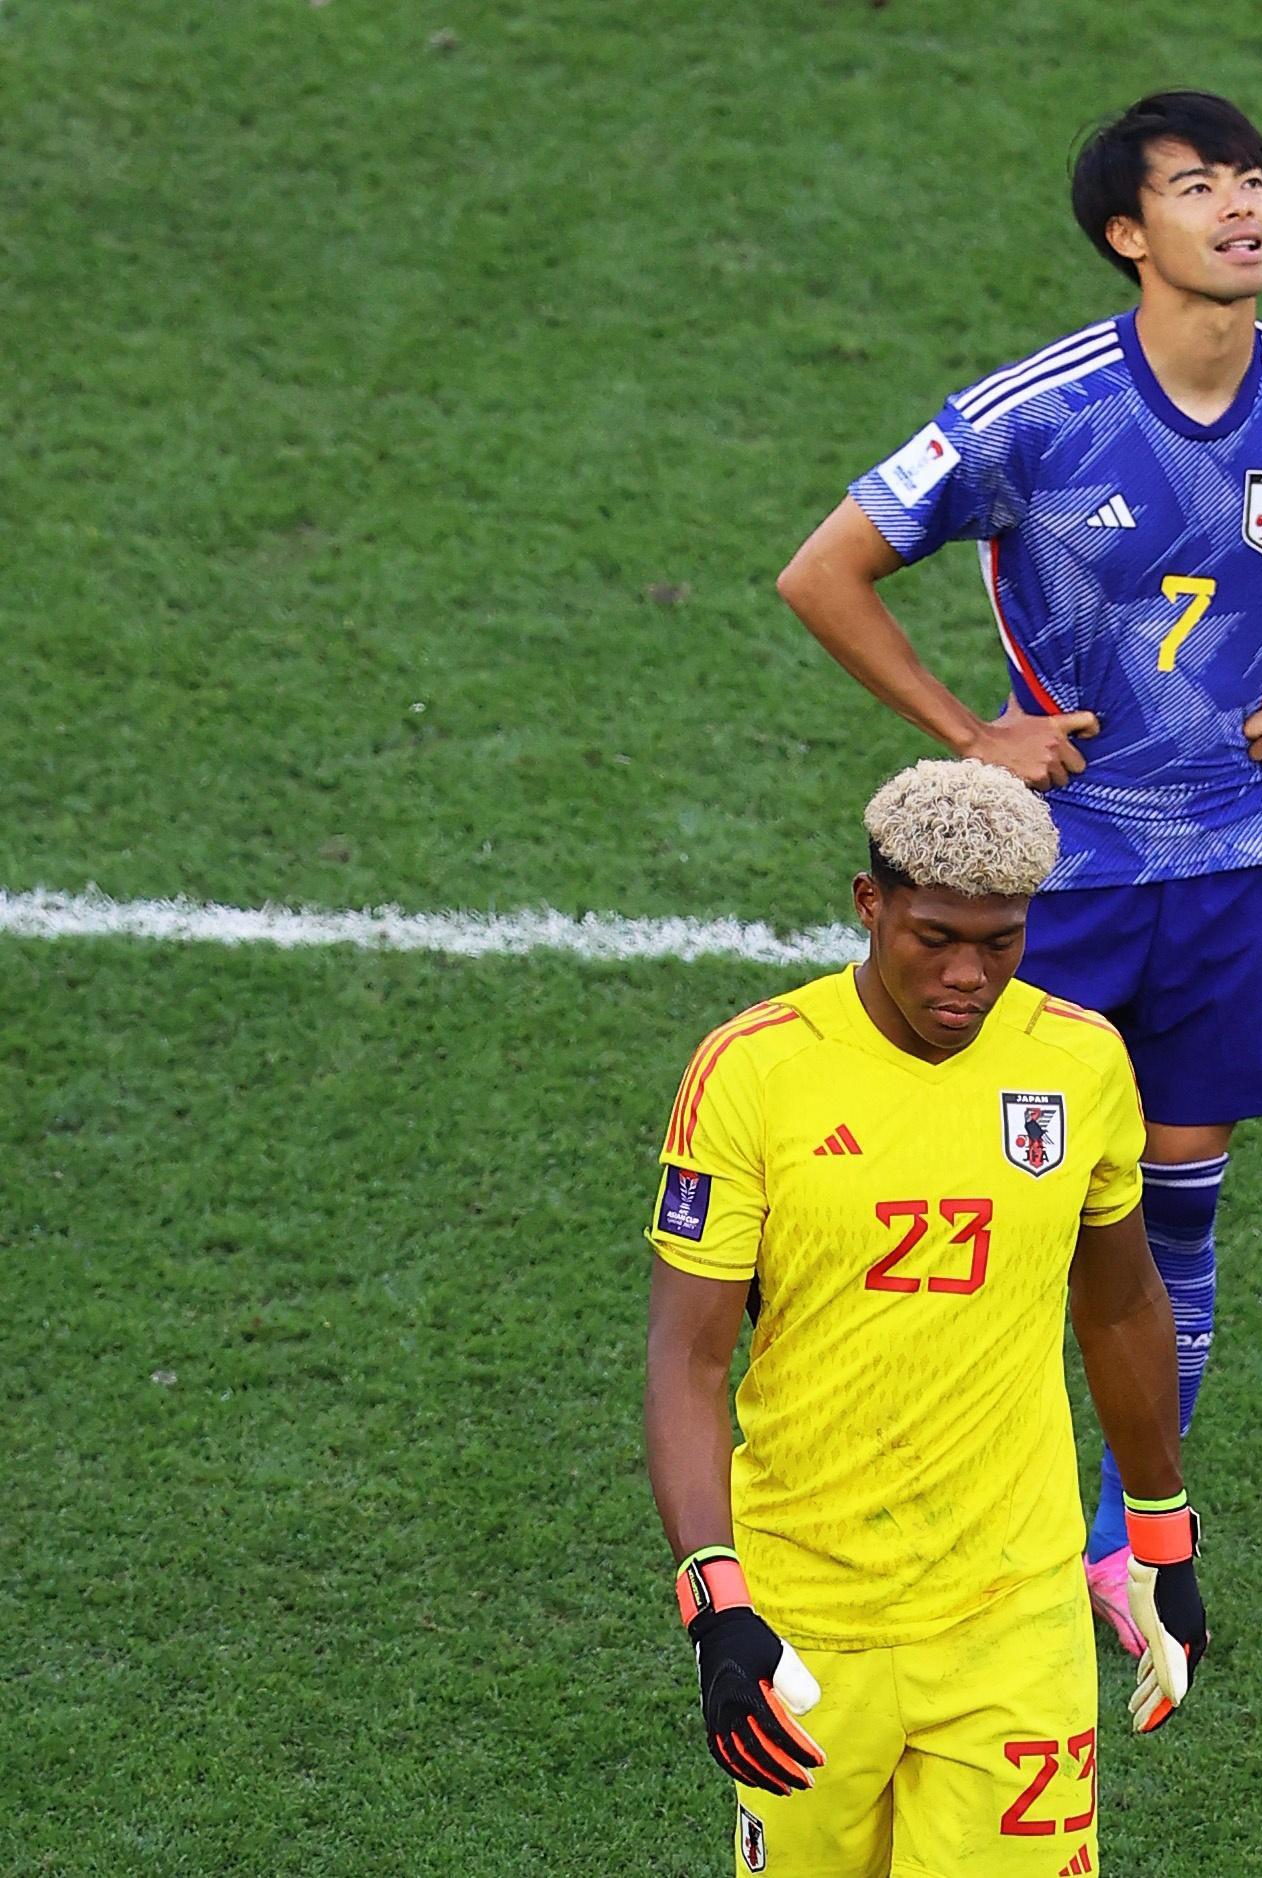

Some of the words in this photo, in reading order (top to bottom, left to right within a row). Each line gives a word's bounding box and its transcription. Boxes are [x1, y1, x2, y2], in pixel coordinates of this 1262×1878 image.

[1158, 575, 1216, 671] 7
[1016, 1094, 1049, 1103] JAPAN
[685, 1215, 700, 1225] CUP
[865, 1199, 993, 1294] 23
[1001, 1728, 1098, 1836] 23
